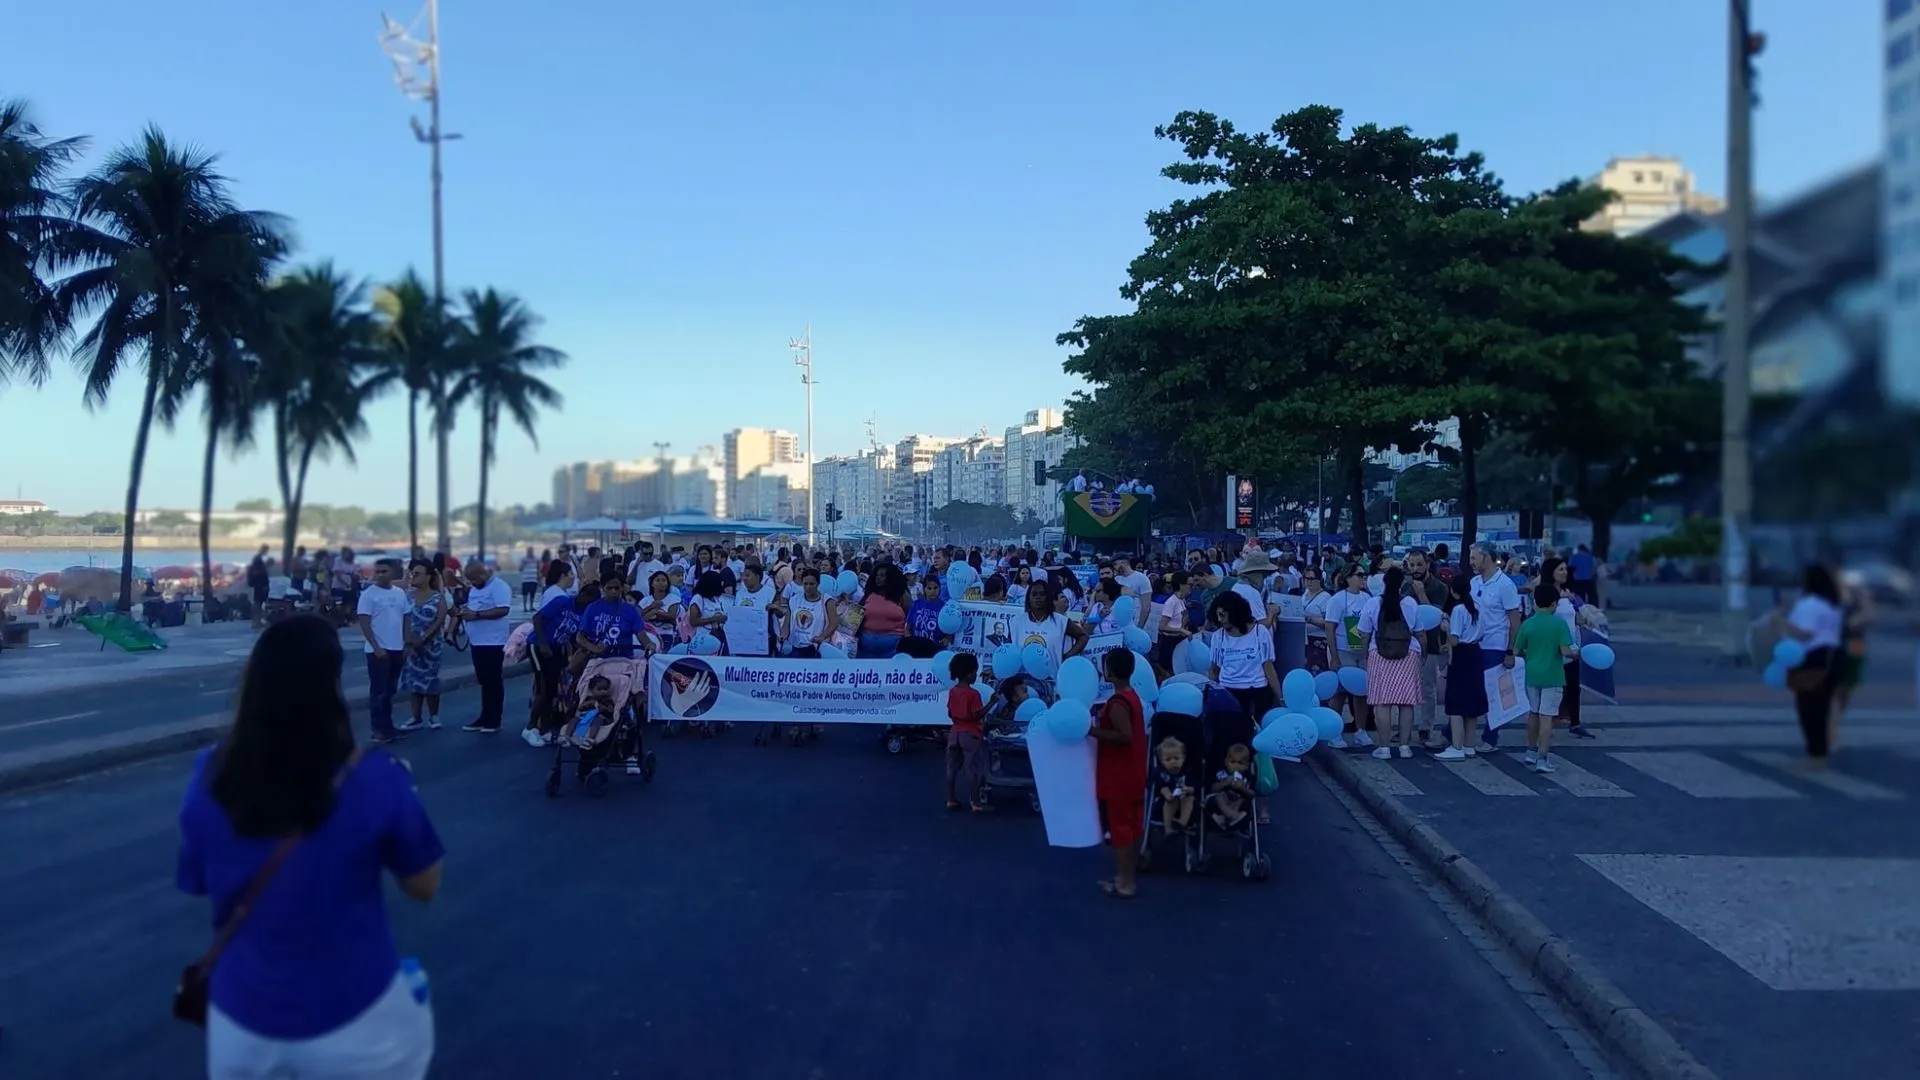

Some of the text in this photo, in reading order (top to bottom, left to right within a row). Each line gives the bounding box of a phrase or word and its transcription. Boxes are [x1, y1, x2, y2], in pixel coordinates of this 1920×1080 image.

[724, 666, 775, 683] Mulheres
[777, 668, 829, 687] precisam
[832, 669, 846, 684] de
[848, 669, 882, 688] ajuda,
[885, 669, 906, 685] não
[909, 669, 923, 685] de
[750, 689, 769, 699] Casa
[802, 690, 823, 700] Padre
[825, 691, 851, 701] Afonso
[888, 692, 910, 702] (Nova
[912, 692, 939, 702] Iguaçu)
